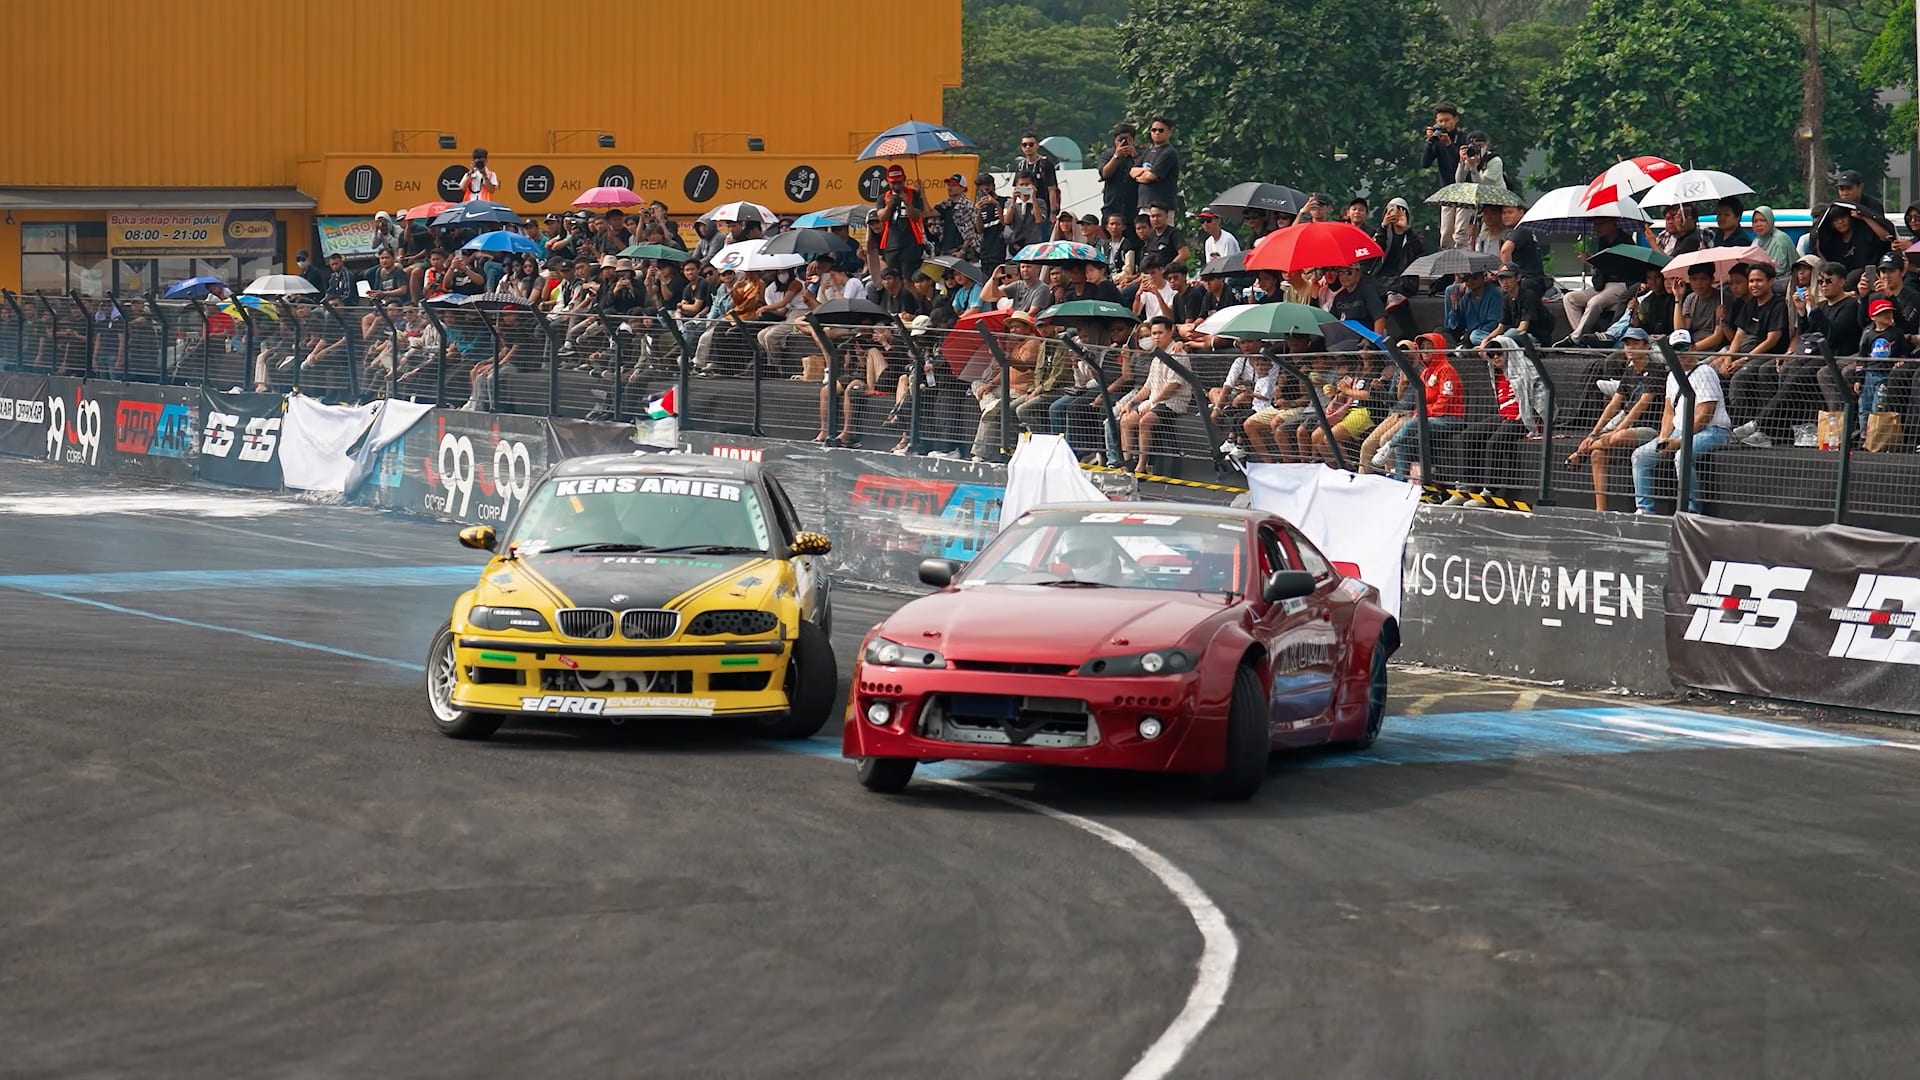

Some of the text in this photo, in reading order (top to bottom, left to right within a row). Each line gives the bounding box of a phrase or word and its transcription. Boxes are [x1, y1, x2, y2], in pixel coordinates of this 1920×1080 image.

[394, 180, 421, 192] BAN
[560, 179, 581, 190] AKI
[640, 179, 667, 190] REM
[725, 178, 768, 190] SHOCK
[825, 179, 843, 190] AC
[111, 215, 220, 227] Buka setiap hari pukul
[124, 229, 160, 241] 08:00
[172, 229, 208, 241] 21:00
[478, 503, 500, 520] CORP
[1442, 555, 1537, 607] GLOW
[1541, 567, 1550, 608] FOR
[1557, 566, 1644, 620] MEN
[1684, 560, 1813, 650] IDS
[1738, 599, 1760, 613] SERIES
[1829, 607, 1870, 624] INDONESIAN
[1889, 613, 1915, 626] SERIES
[560, 655, 574, 667] TOW
[604, 696, 717, 709] ENGINEERING
